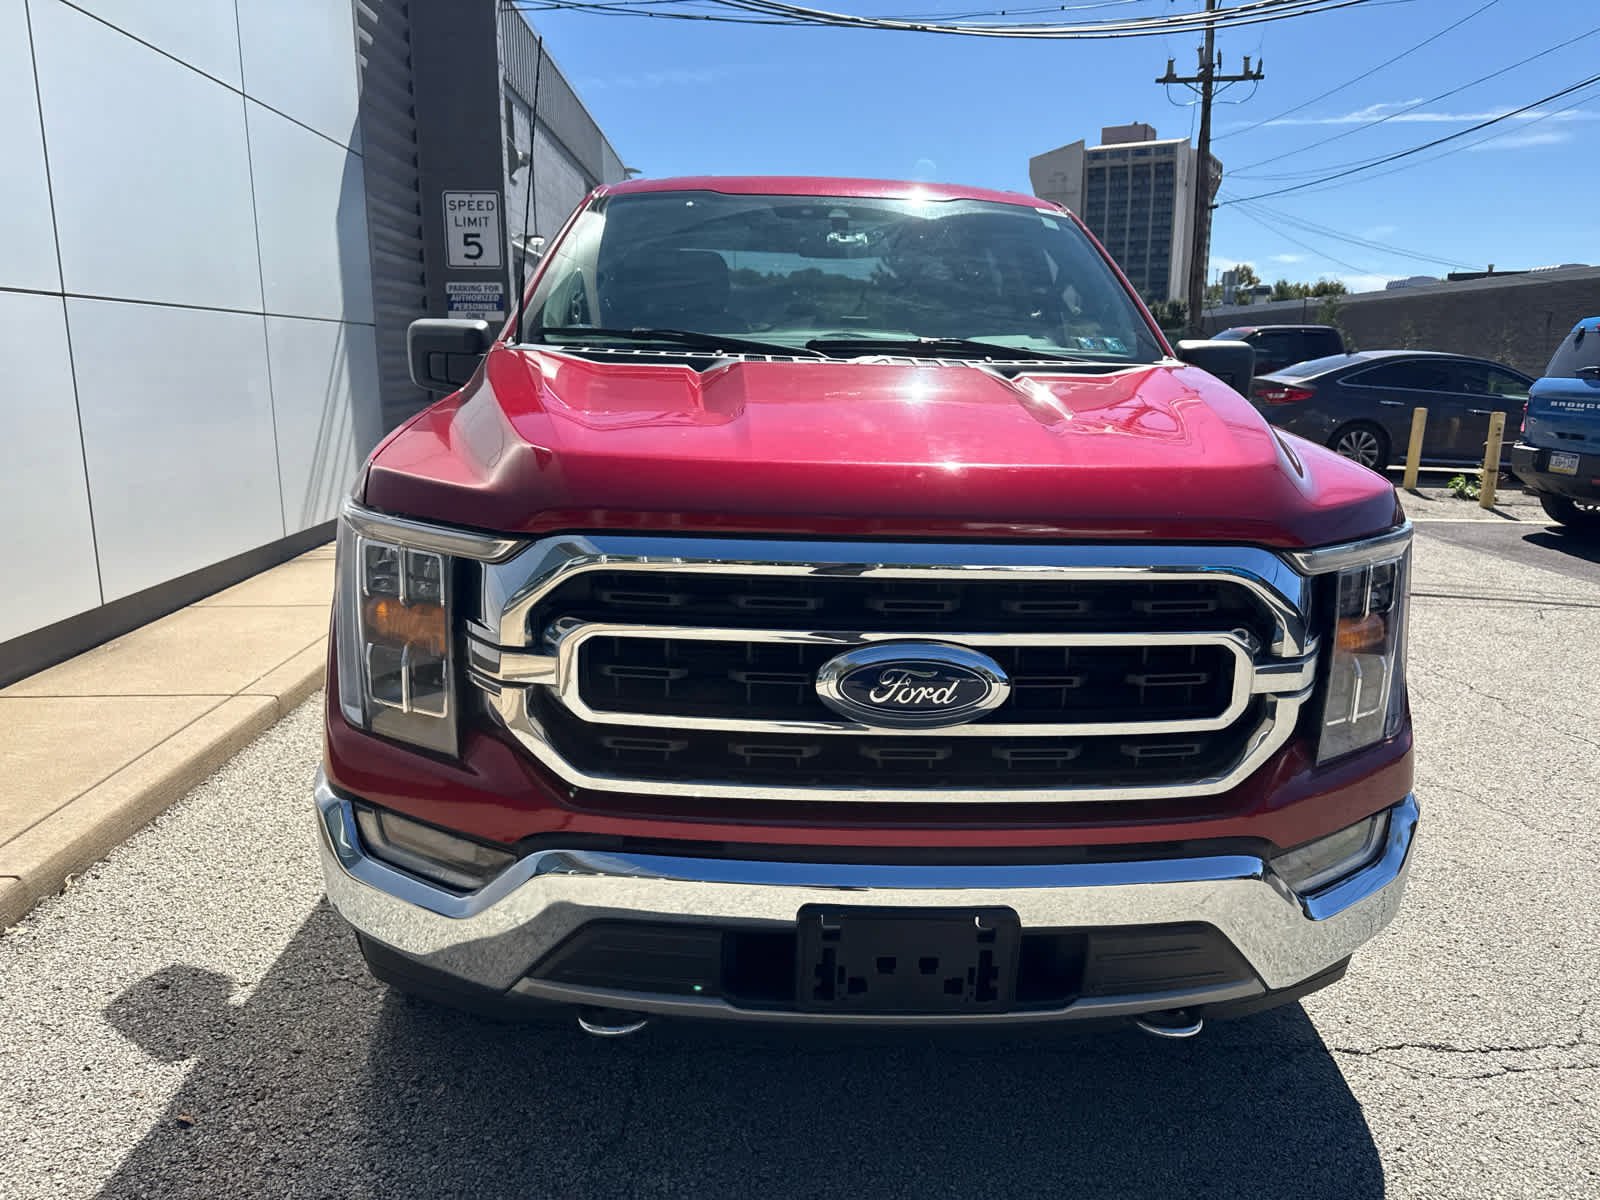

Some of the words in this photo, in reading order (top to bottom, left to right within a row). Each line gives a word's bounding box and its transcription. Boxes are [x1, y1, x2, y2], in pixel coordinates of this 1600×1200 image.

[448, 200, 495, 211] SPEED
[454, 216, 489, 228] LIMIT
[463, 233, 483, 260] 5
[448, 284, 481, 293] PARKING
[484, 284, 500, 293] FOR
[450, 294, 500, 302] AUTHORIZED
[869, 668, 960, 704] Ford
